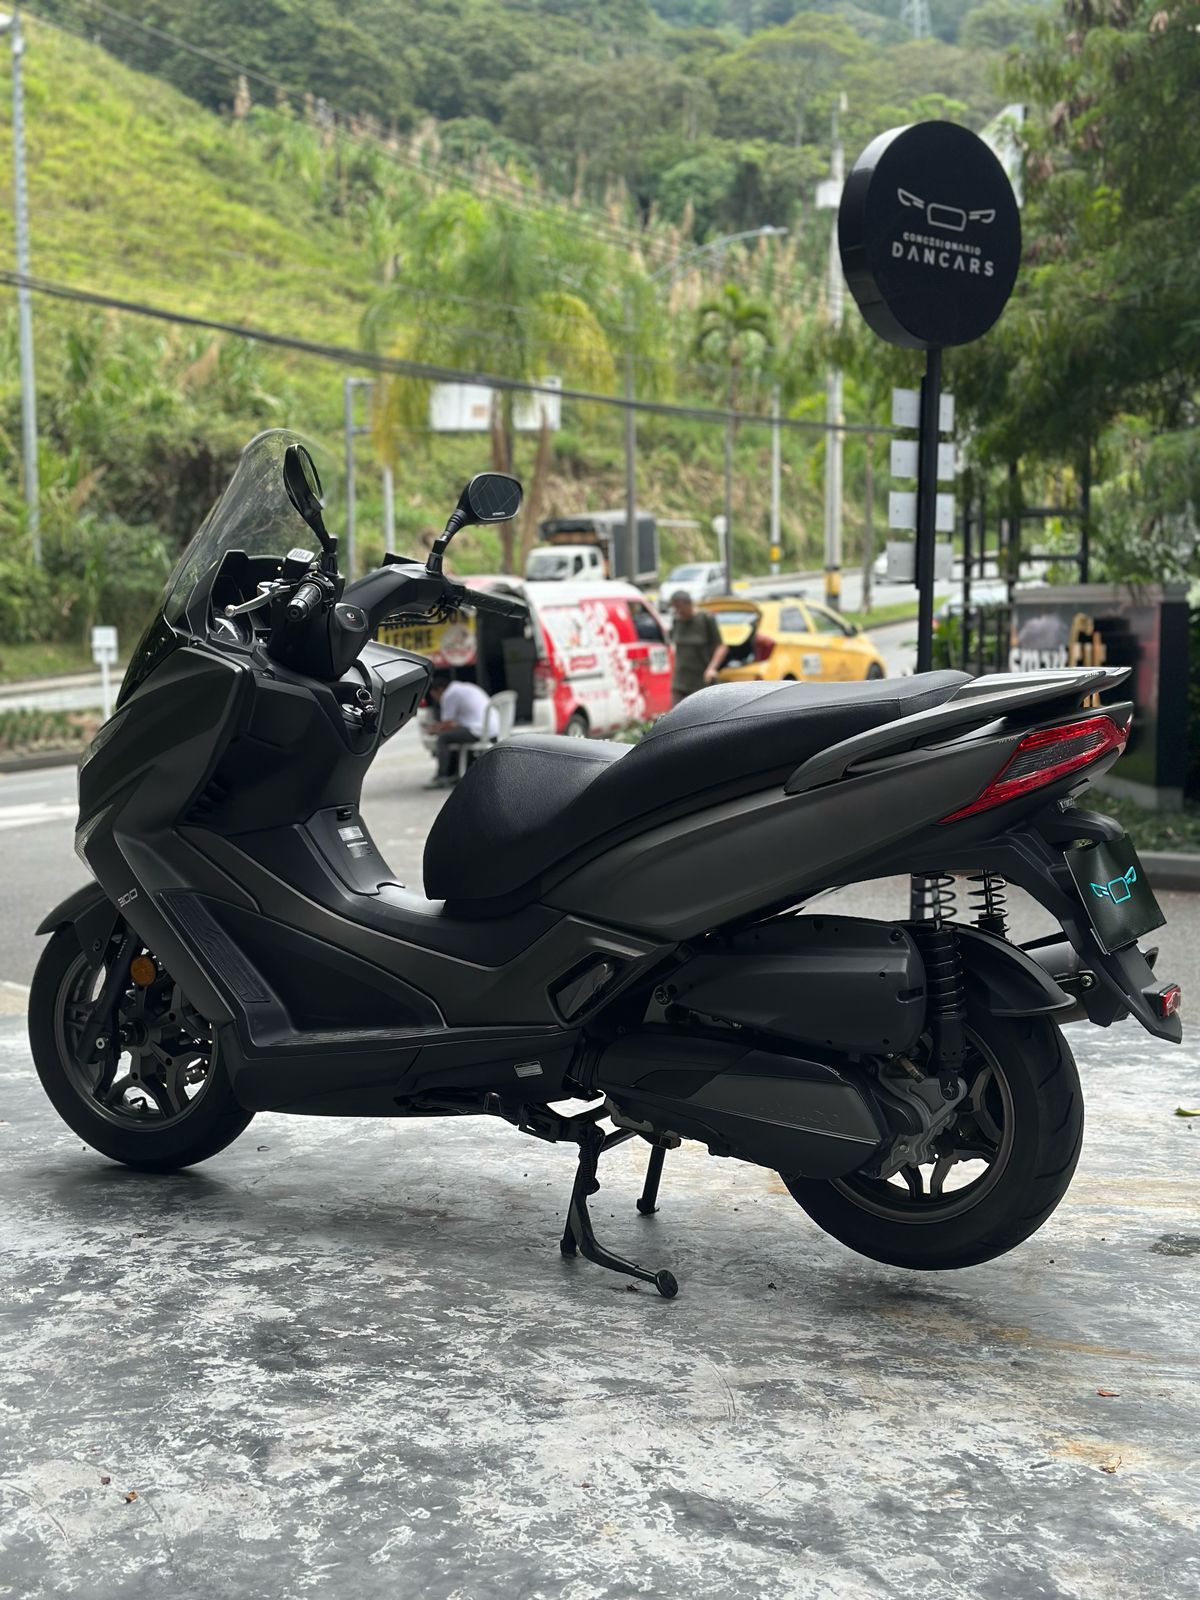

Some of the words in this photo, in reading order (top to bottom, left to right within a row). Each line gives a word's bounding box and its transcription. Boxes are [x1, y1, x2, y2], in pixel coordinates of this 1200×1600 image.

[903, 231, 982, 256] CONCESIONARIO
[892, 240, 994, 277] DANCARS
[117, 887, 138, 908] 300
